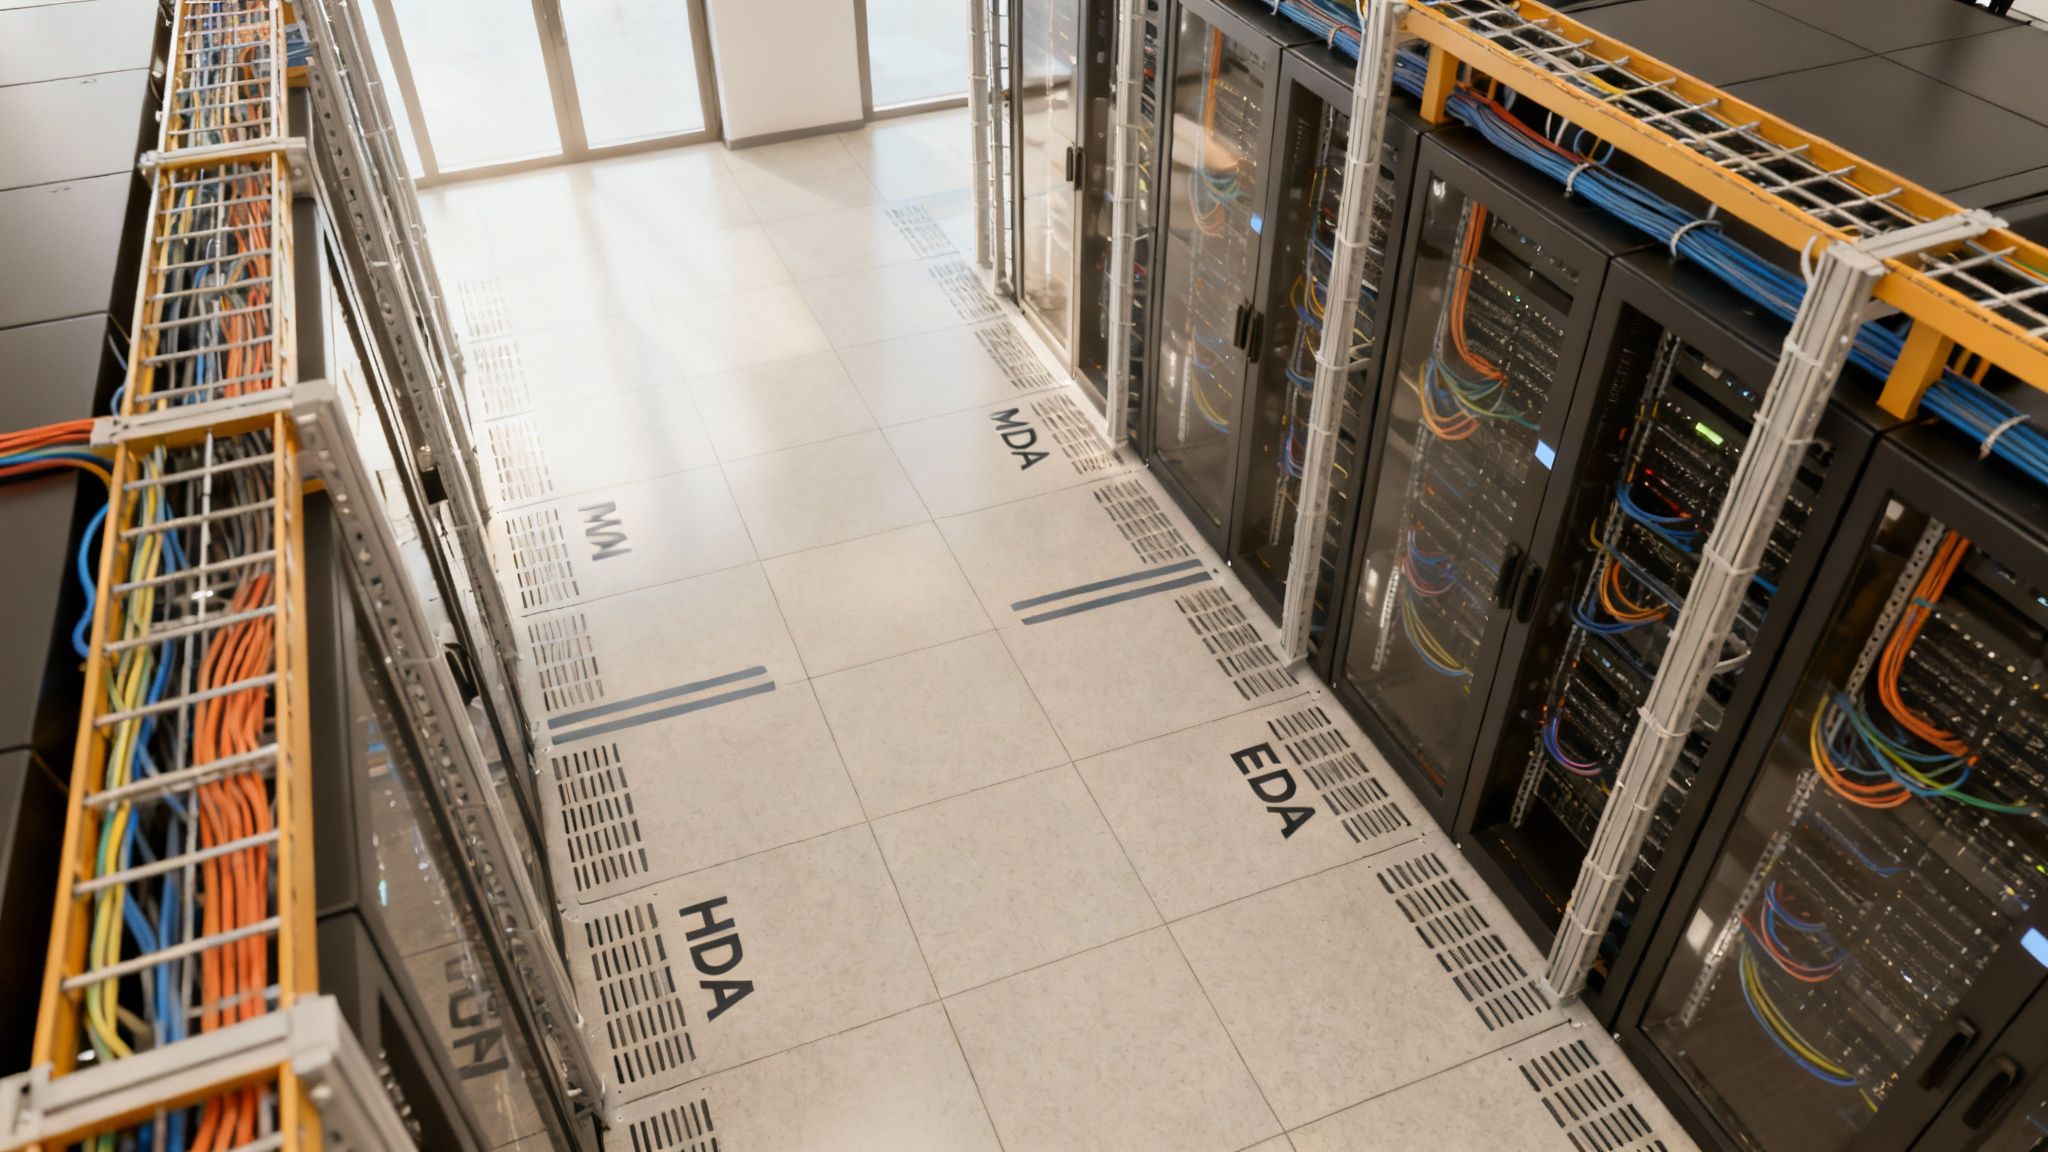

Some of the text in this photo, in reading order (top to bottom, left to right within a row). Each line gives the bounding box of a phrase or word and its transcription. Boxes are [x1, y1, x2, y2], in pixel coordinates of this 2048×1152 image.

[989, 407, 1050, 471] MDA
[1229, 741, 1316, 840] EDA
[679, 895, 755, 1023] HDA
